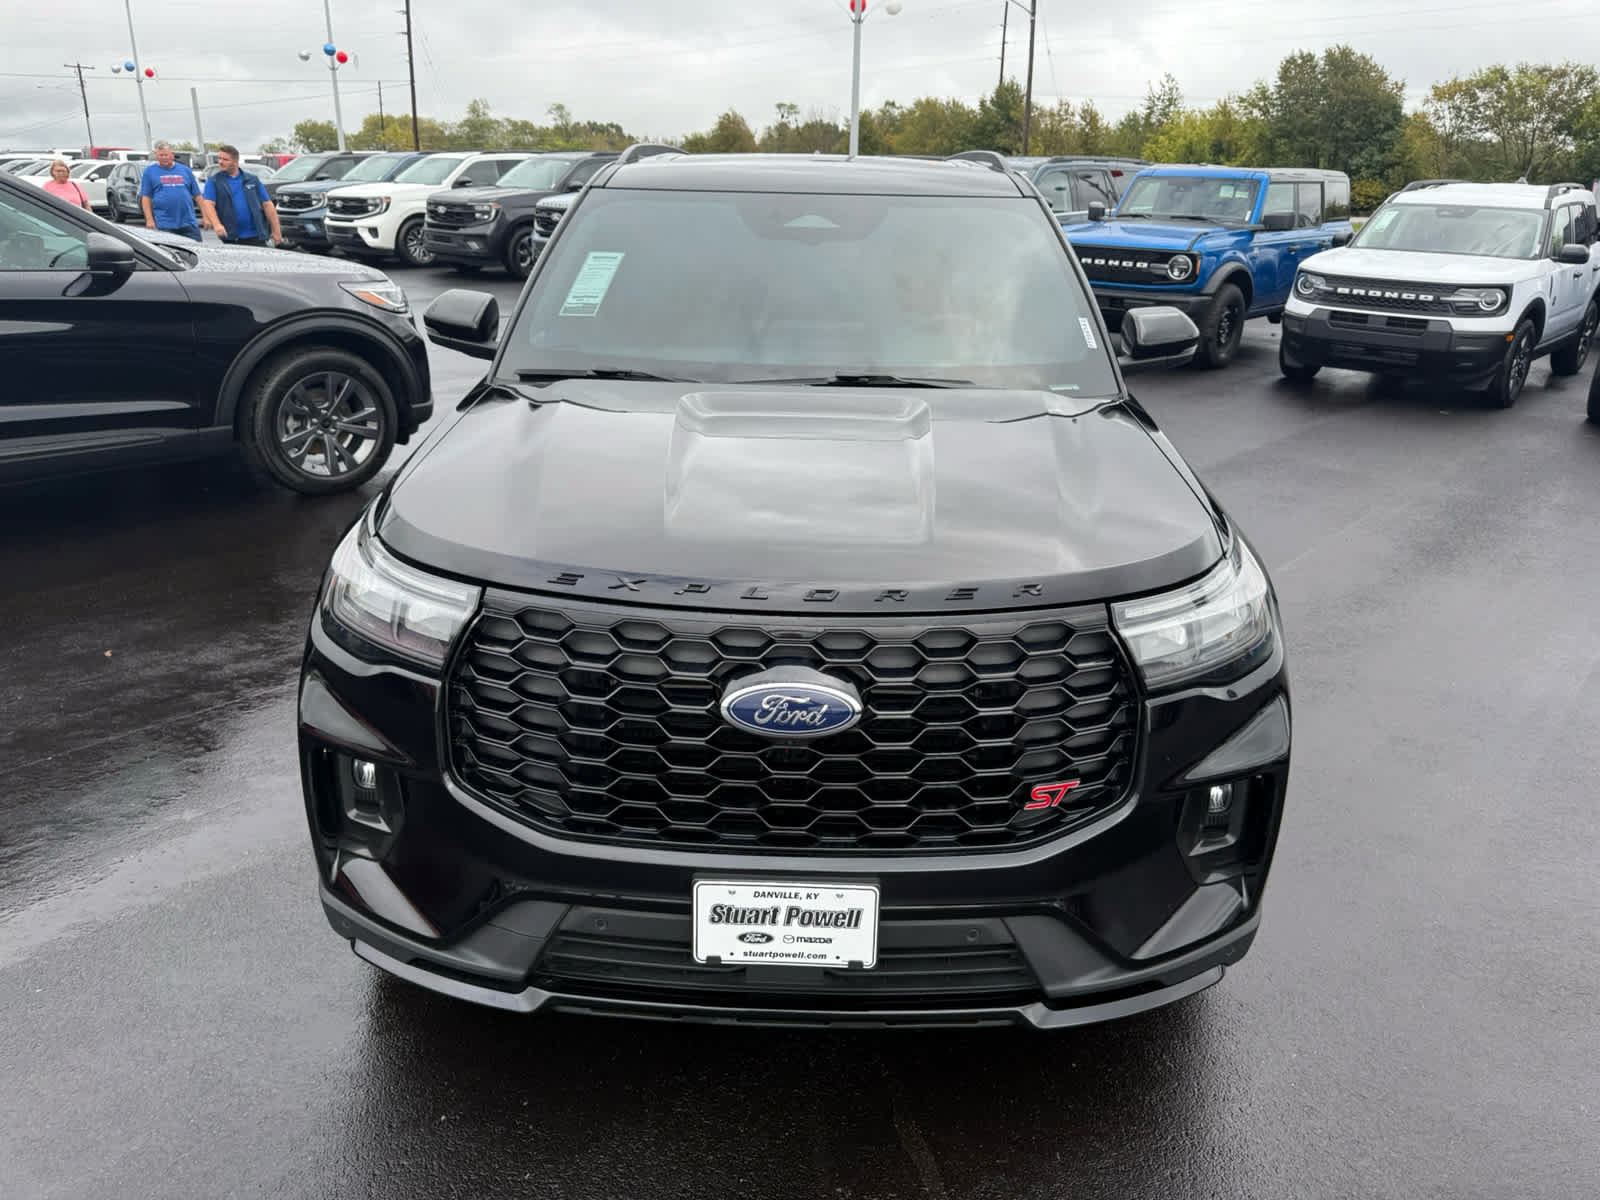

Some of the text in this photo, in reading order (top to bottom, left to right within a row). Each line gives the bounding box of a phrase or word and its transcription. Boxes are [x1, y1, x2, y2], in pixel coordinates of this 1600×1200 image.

[1081, 257, 1148, 268] RONCO
[1337, 287, 1433, 301] BRONCO
[547, 571, 1047, 602] EXPLORER
[754, 694, 828, 726] Ford
[1024, 780, 1080, 810] ST
[753, 890, 820, 900] DANVILLE, KY
[709, 903, 864, 928] Stuart Powell
[743, 950, 827, 960] stuartpowell.com
